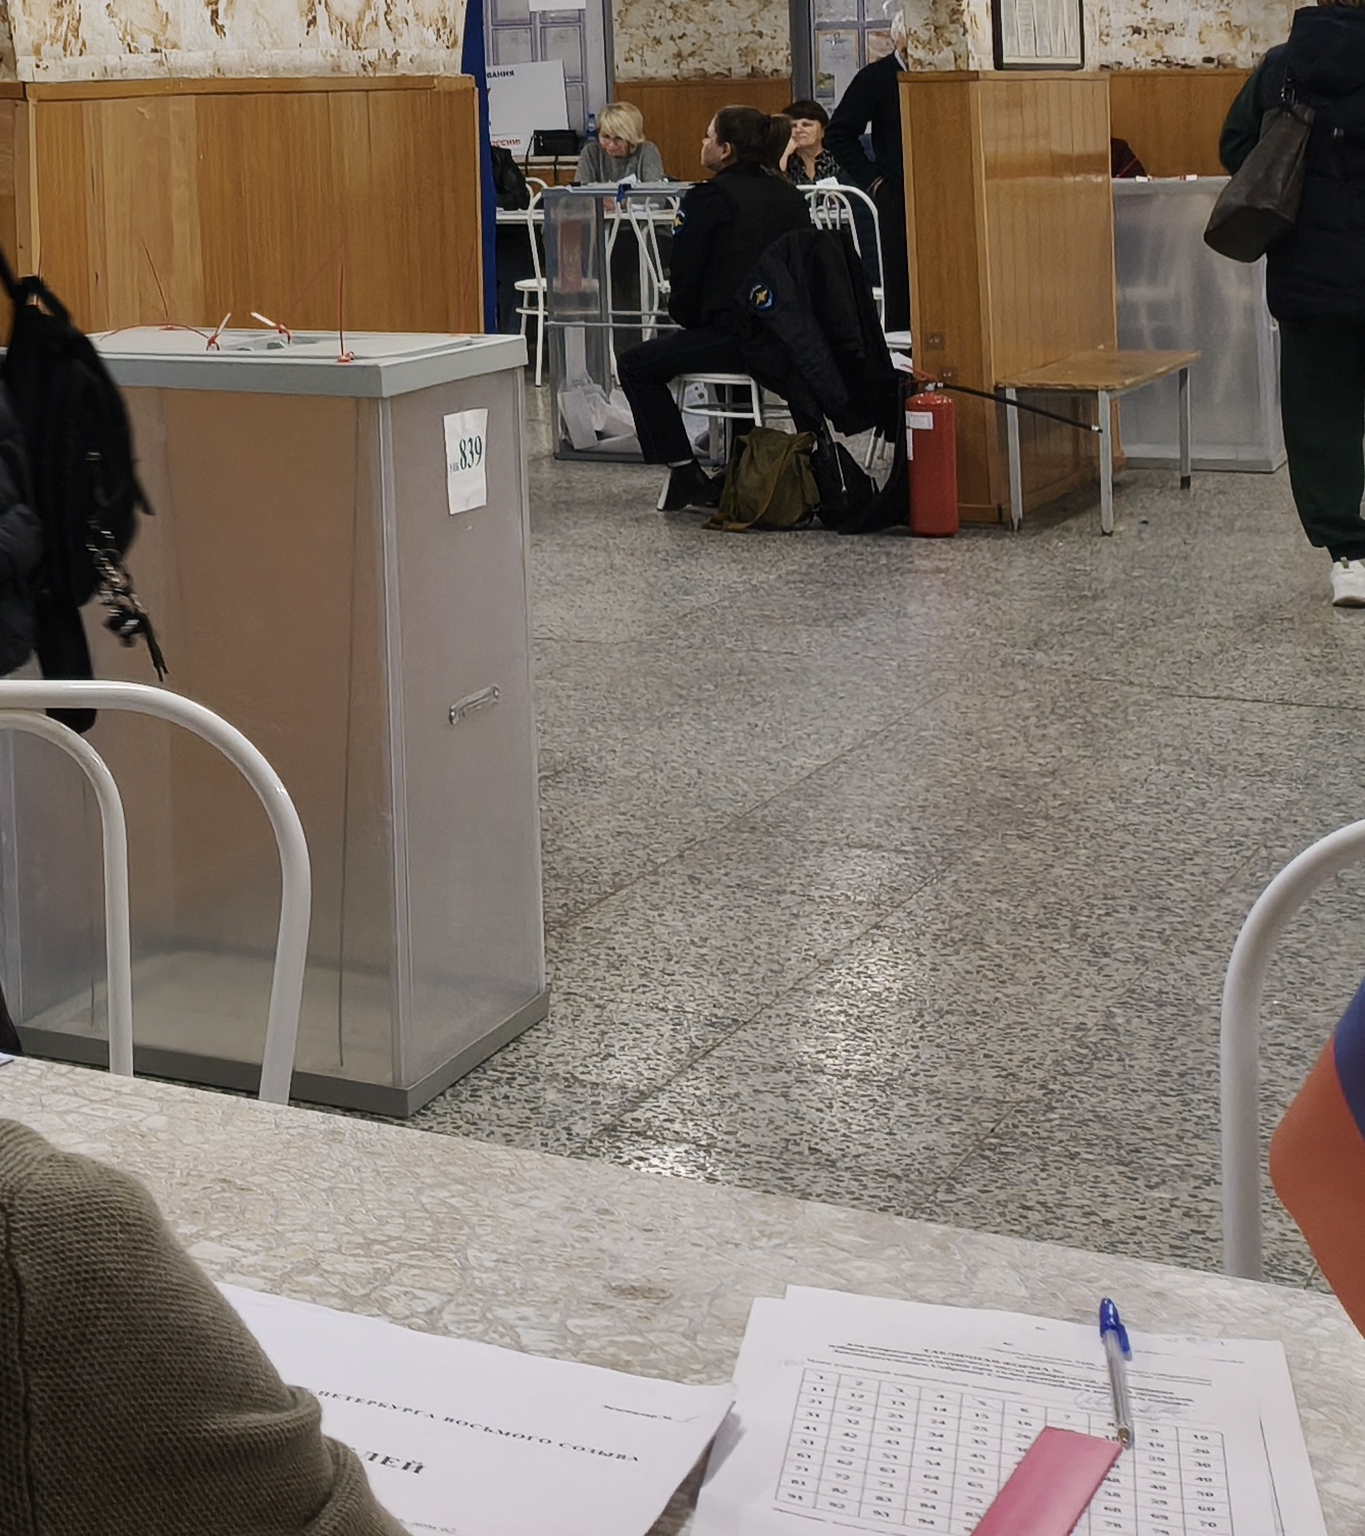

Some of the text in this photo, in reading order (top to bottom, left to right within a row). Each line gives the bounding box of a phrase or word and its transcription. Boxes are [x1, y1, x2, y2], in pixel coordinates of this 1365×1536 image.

[459, 435, 483, 470] 839
[444, 1416, 552, 1445] ВОСЬМОГО
[558, 1442, 639, 1462] СОЗЫВА
[363, 1450, 427, 1474] ЛЕЙ
